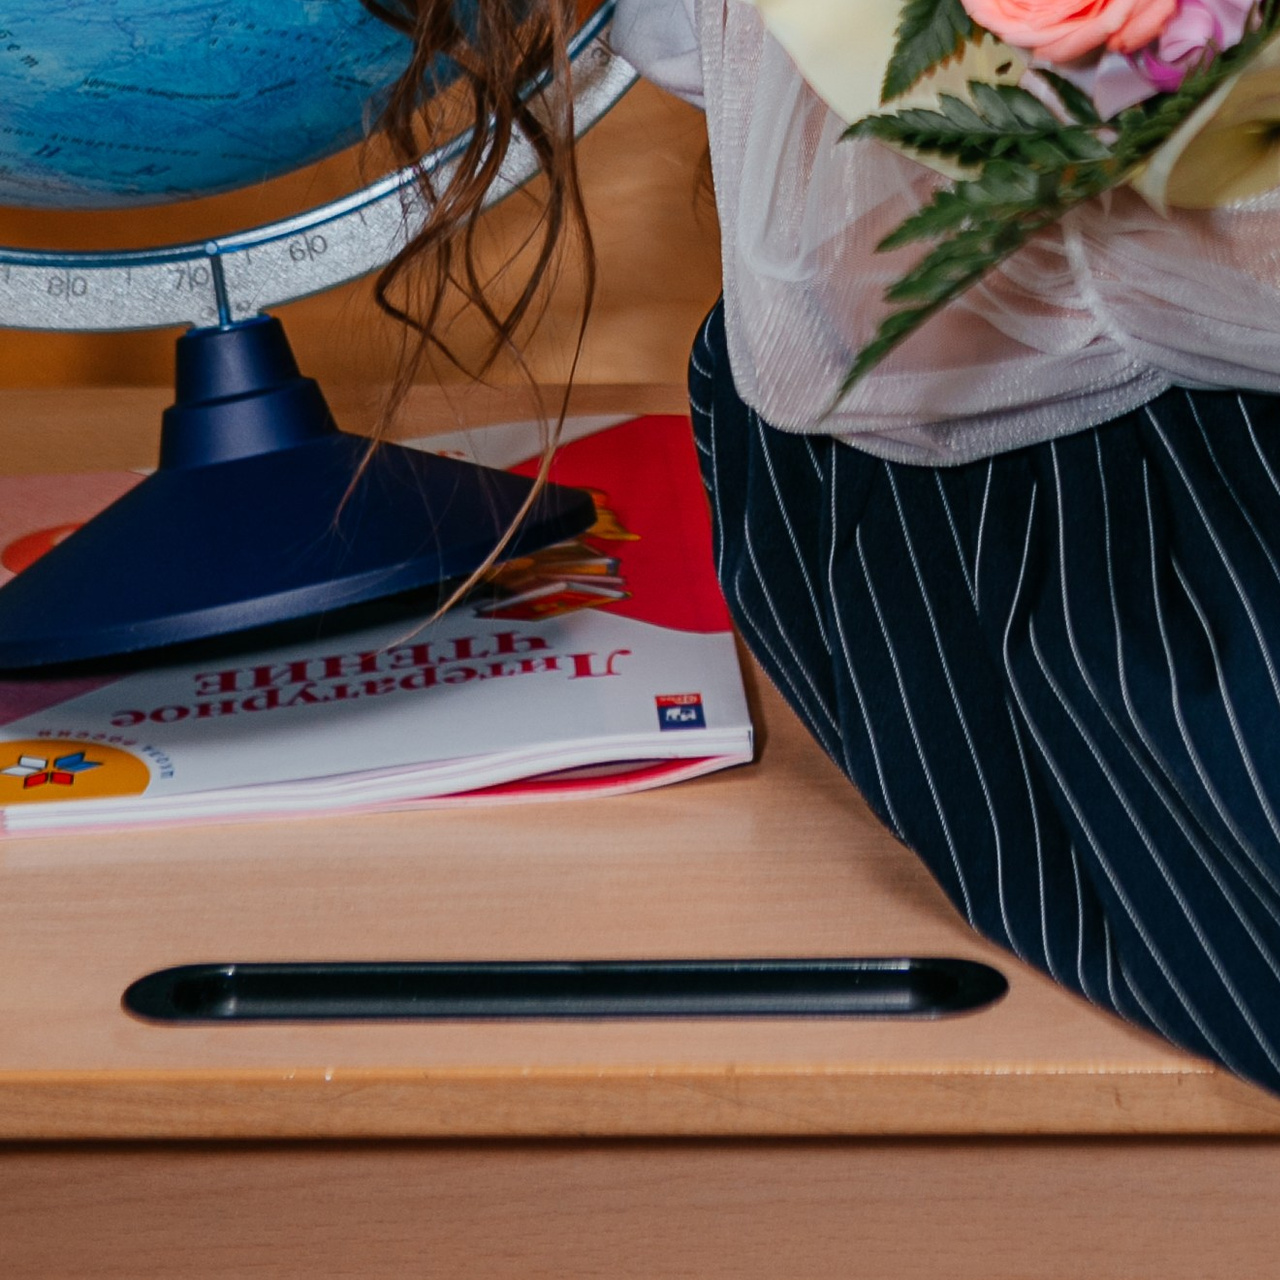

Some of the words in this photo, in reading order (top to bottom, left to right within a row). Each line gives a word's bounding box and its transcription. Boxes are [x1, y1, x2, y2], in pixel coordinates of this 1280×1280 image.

[288, 234, 329, 263] 60
[168, 265, 210, 292] 70
[194, 630, 555, 697] ЧТЕНИЕ
[111, 648, 632, 728] Литературное
